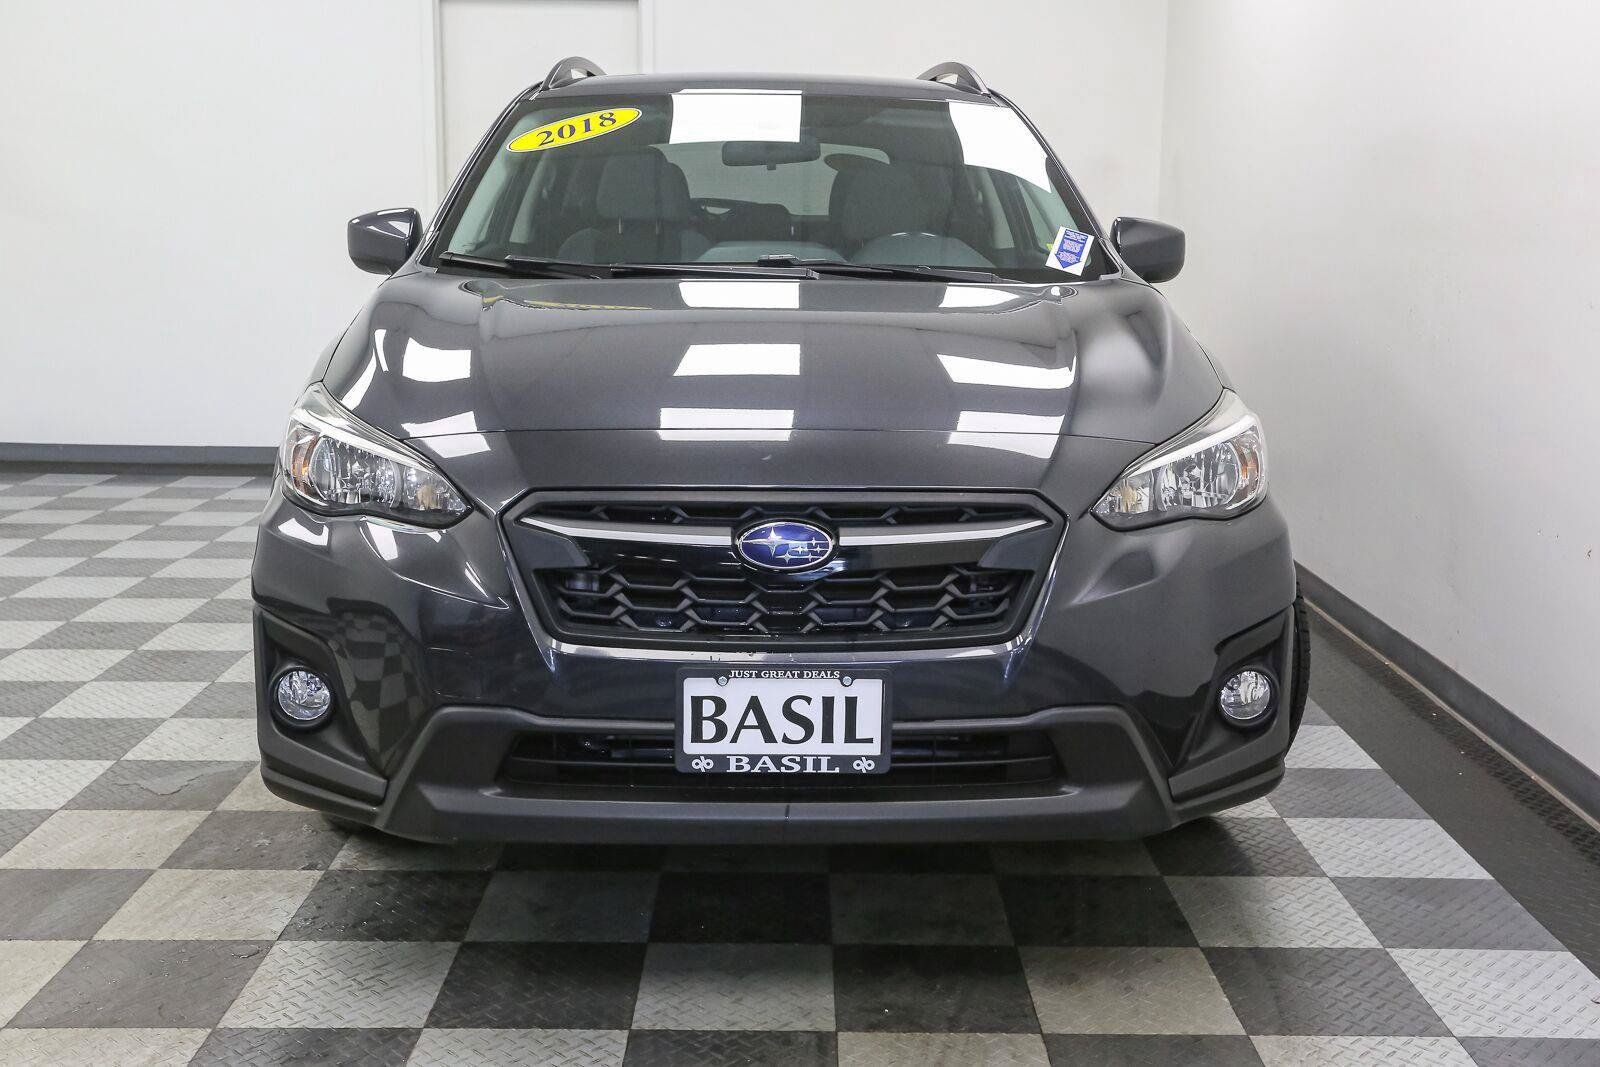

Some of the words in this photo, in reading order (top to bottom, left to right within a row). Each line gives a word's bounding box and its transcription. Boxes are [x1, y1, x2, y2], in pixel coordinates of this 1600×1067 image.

[536, 112, 617, 147] 2018
[728, 670, 758, 679] JUST
[761, 670, 801, 679] GREAT
[803, 671, 840, 679] DEALS
[690, 695, 874, 745] BASIL
[726, 755, 840, 773] BASIL
